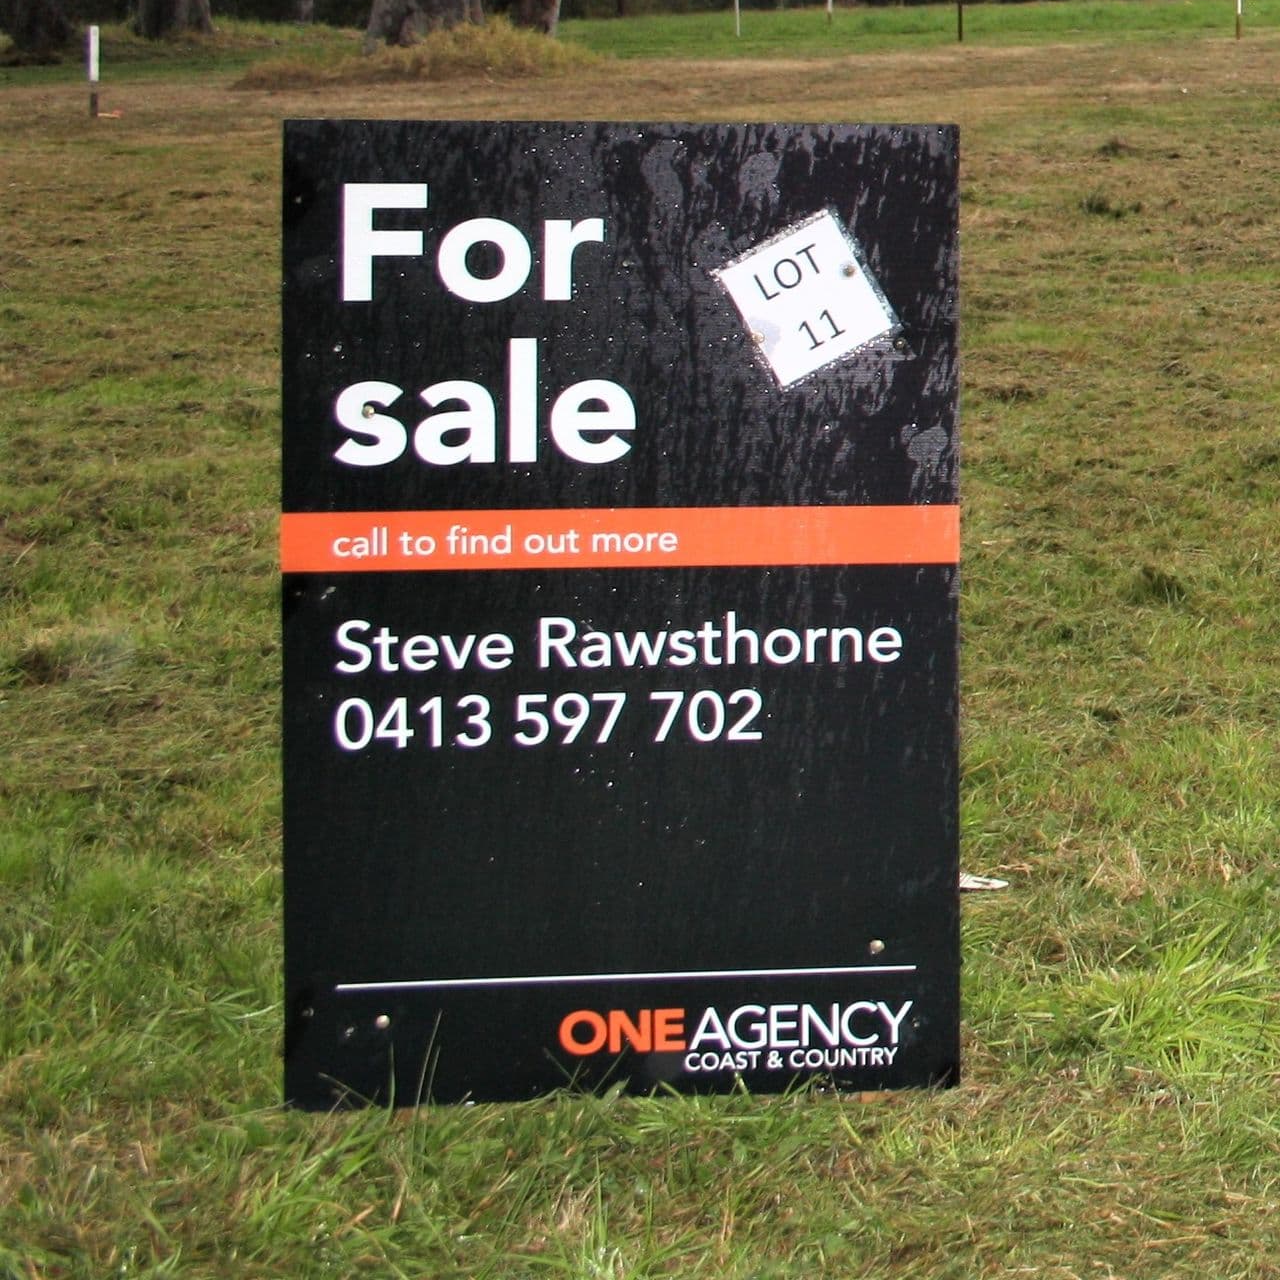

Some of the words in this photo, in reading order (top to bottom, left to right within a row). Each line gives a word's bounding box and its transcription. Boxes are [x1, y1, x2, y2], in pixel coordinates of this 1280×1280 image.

[342, 183, 604, 303] For
[754, 243, 820, 301] LOT
[798, 309, 845, 351] 11
[334, 337, 636, 467] sale
[331, 526, 388, 559] call
[398, 531, 436, 557] to
[445, 524, 512, 555] find
[523, 529, 581, 555] out
[591, 531, 679, 553] more
[335, 619, 514, 674] Steve
[539, 610, 903, 669] Rawsthorne
[335, 694, 492, 751] 0413
[514, 692, 626, 746] 597
[649, 688, 763, 742] 702
[684, 1050, 762, 1072] COAST
[766, 1050, 783, 1069] &
[788, 1044, 899, 1069] COUNTRY
